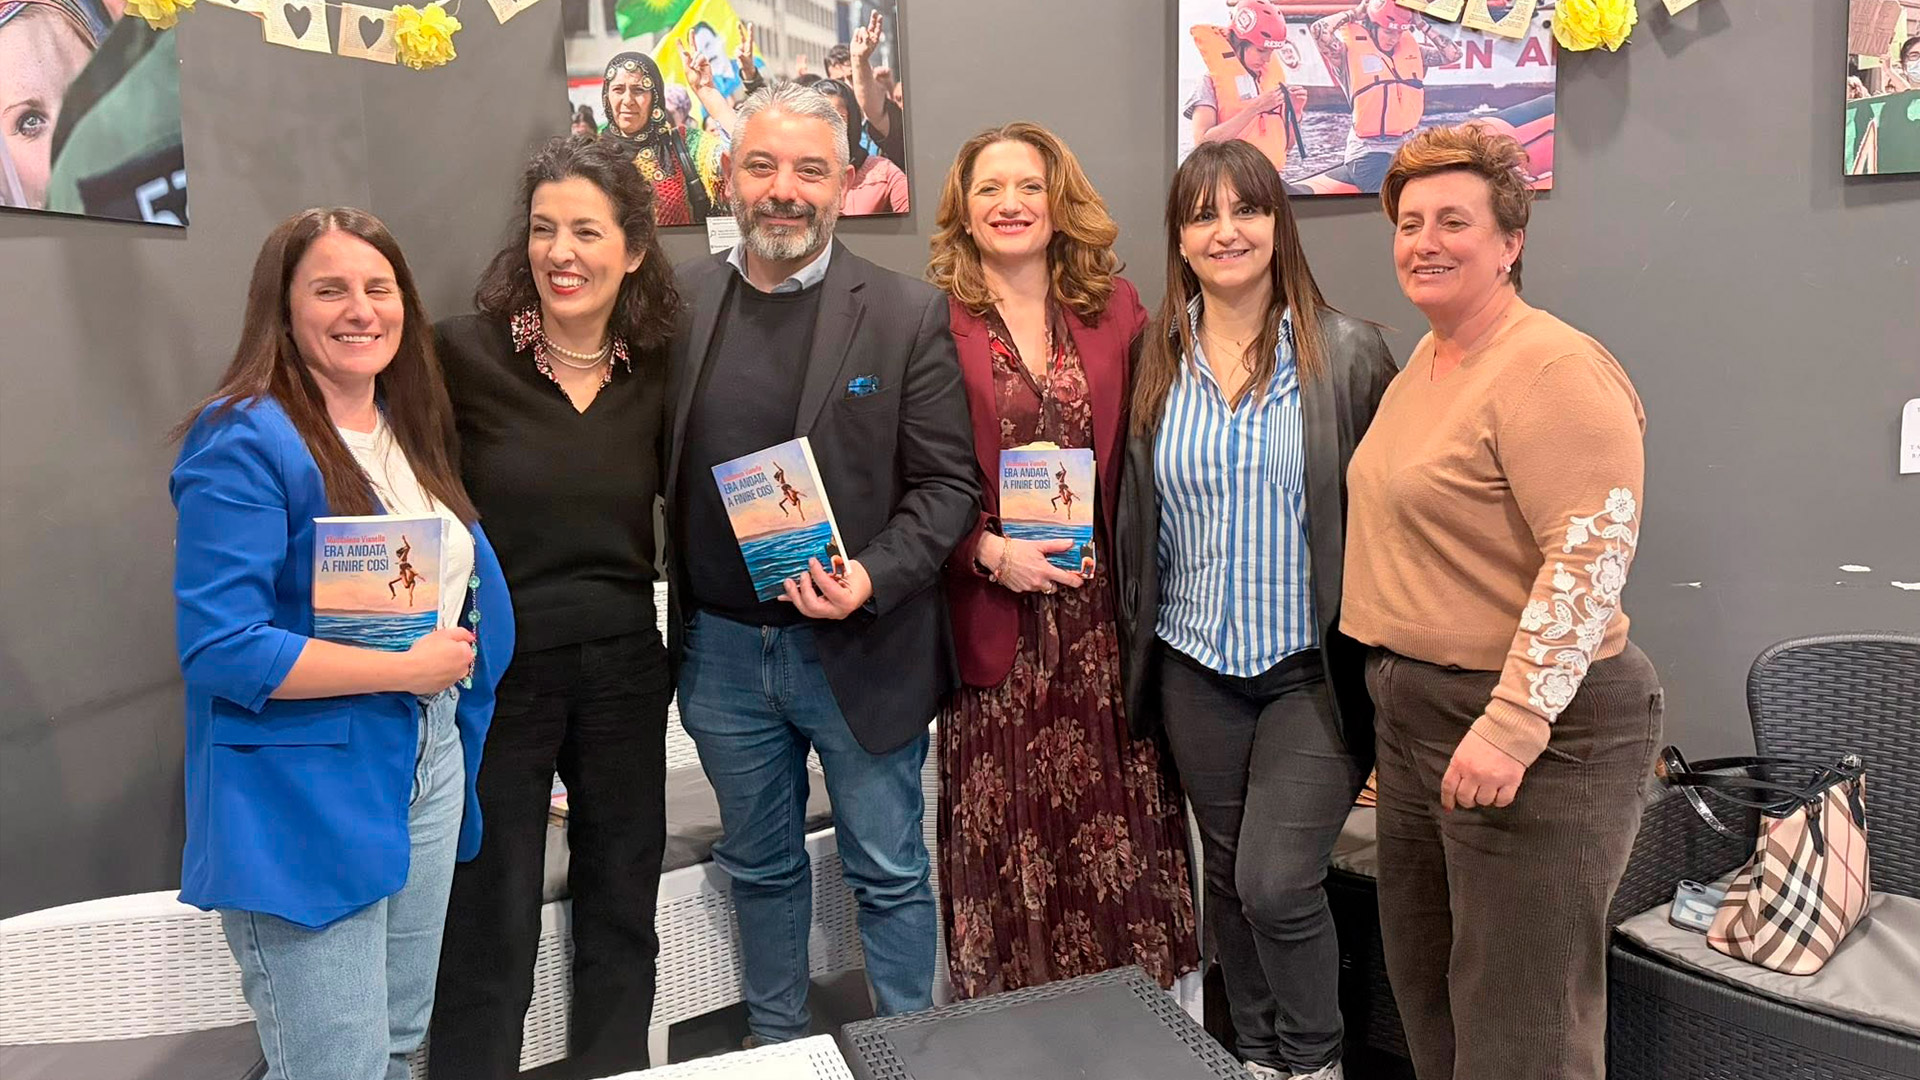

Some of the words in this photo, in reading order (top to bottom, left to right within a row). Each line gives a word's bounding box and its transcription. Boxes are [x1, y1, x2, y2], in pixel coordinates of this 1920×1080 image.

[1004, 467, 1019, 478] ERA
[1019, 467, 1049, 478] ANDATA
[723, 482, 740, 495] ERA
[1003, 480, 1009, 490] A
[1010, 479, 1034, 490] FINIRE
[727, 497, 735, 508] A
[323, 545, 345, 558] ERA
[346, 543, 388, 557] ANDATA
[321, 560, 330, 573] A
[332, 559, 365, 573] FINIRE
[366, 556, 390, 571] COSÌ
